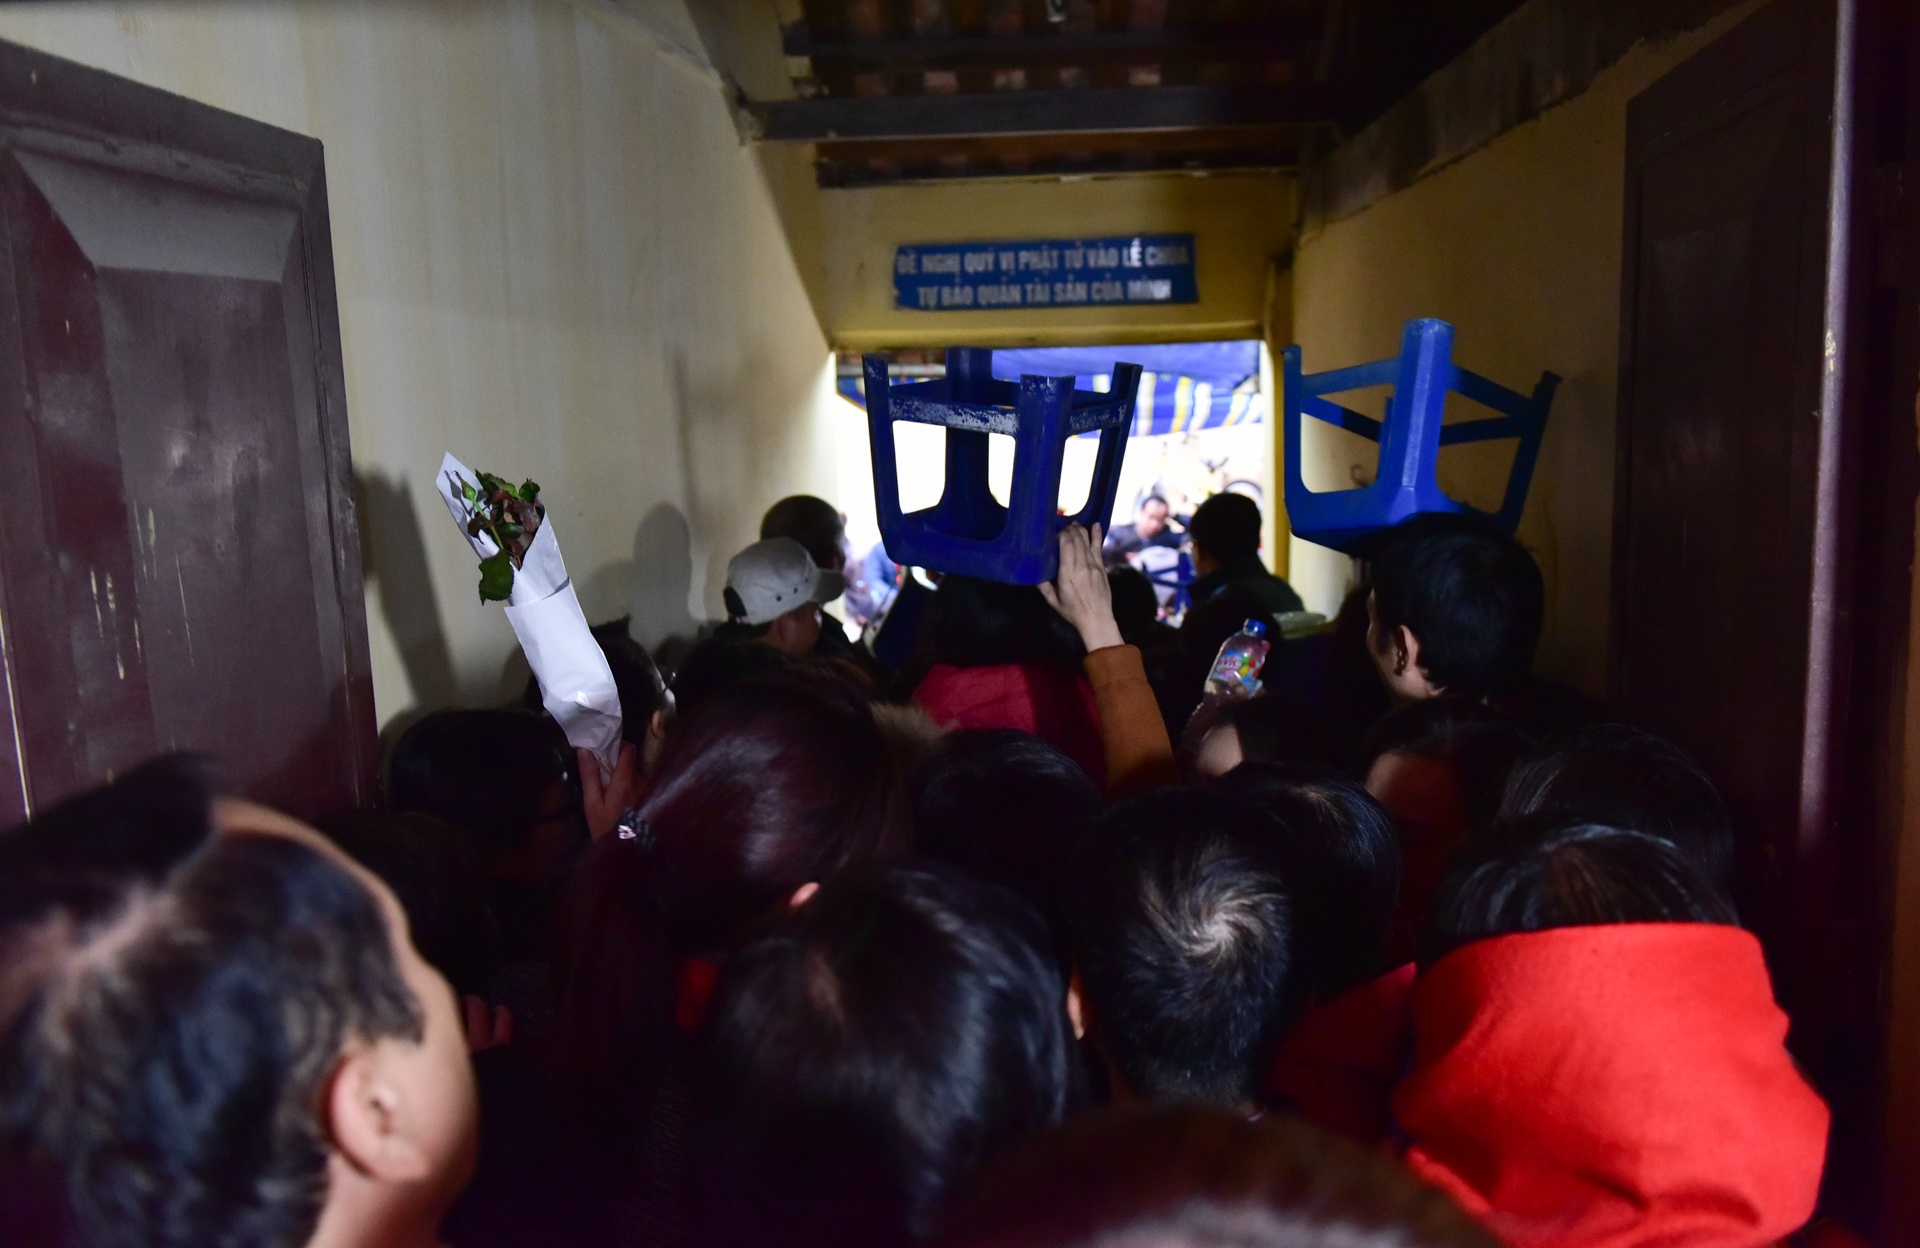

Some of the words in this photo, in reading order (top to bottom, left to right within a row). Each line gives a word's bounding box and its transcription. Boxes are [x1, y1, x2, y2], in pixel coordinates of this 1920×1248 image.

[963, 246, 996, 275] QUÝ
[999, 250, 1016, 276] VỊ
[1086, 242, 1119, 269] VÀO
[1121, 237, 1143, 268] LỄ
[941, 277, 974, 307] BẢO
[976, 276, 1022, 306] QUẢN
[1025, 277, 1051, 304] TÀI
[1053, 274, 1088, 303] SẢN
[1091, 273, 1125, 302] CỦA
